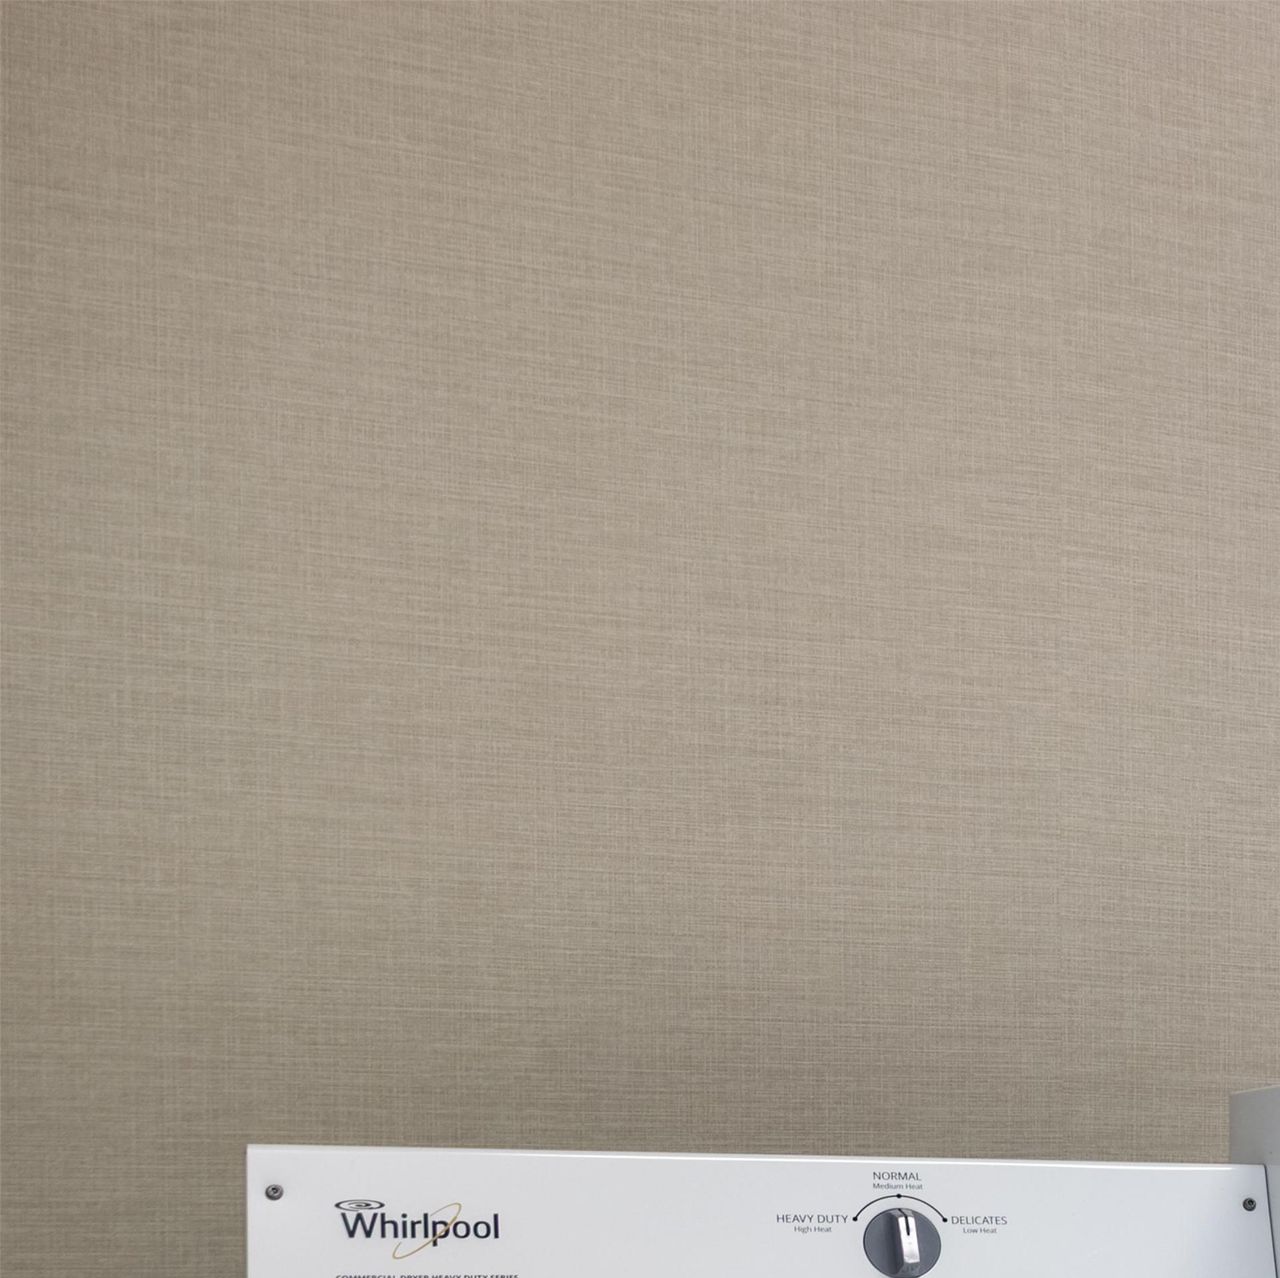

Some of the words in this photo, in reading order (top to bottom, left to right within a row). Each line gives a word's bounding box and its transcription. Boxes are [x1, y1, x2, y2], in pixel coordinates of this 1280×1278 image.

[873, 1171, 922, 1181] NORMAL
[872, 1182, 903, 1190] Medium
[776, 1214, 814, 1223] HEAVY
[817, 1214, 849, 1223] DUTY
[951, 1215, 1008, 1225] DELICATES
[341, 1212, 500, 1247] Whirlpool
[794, 1226, 812, 1235] High
